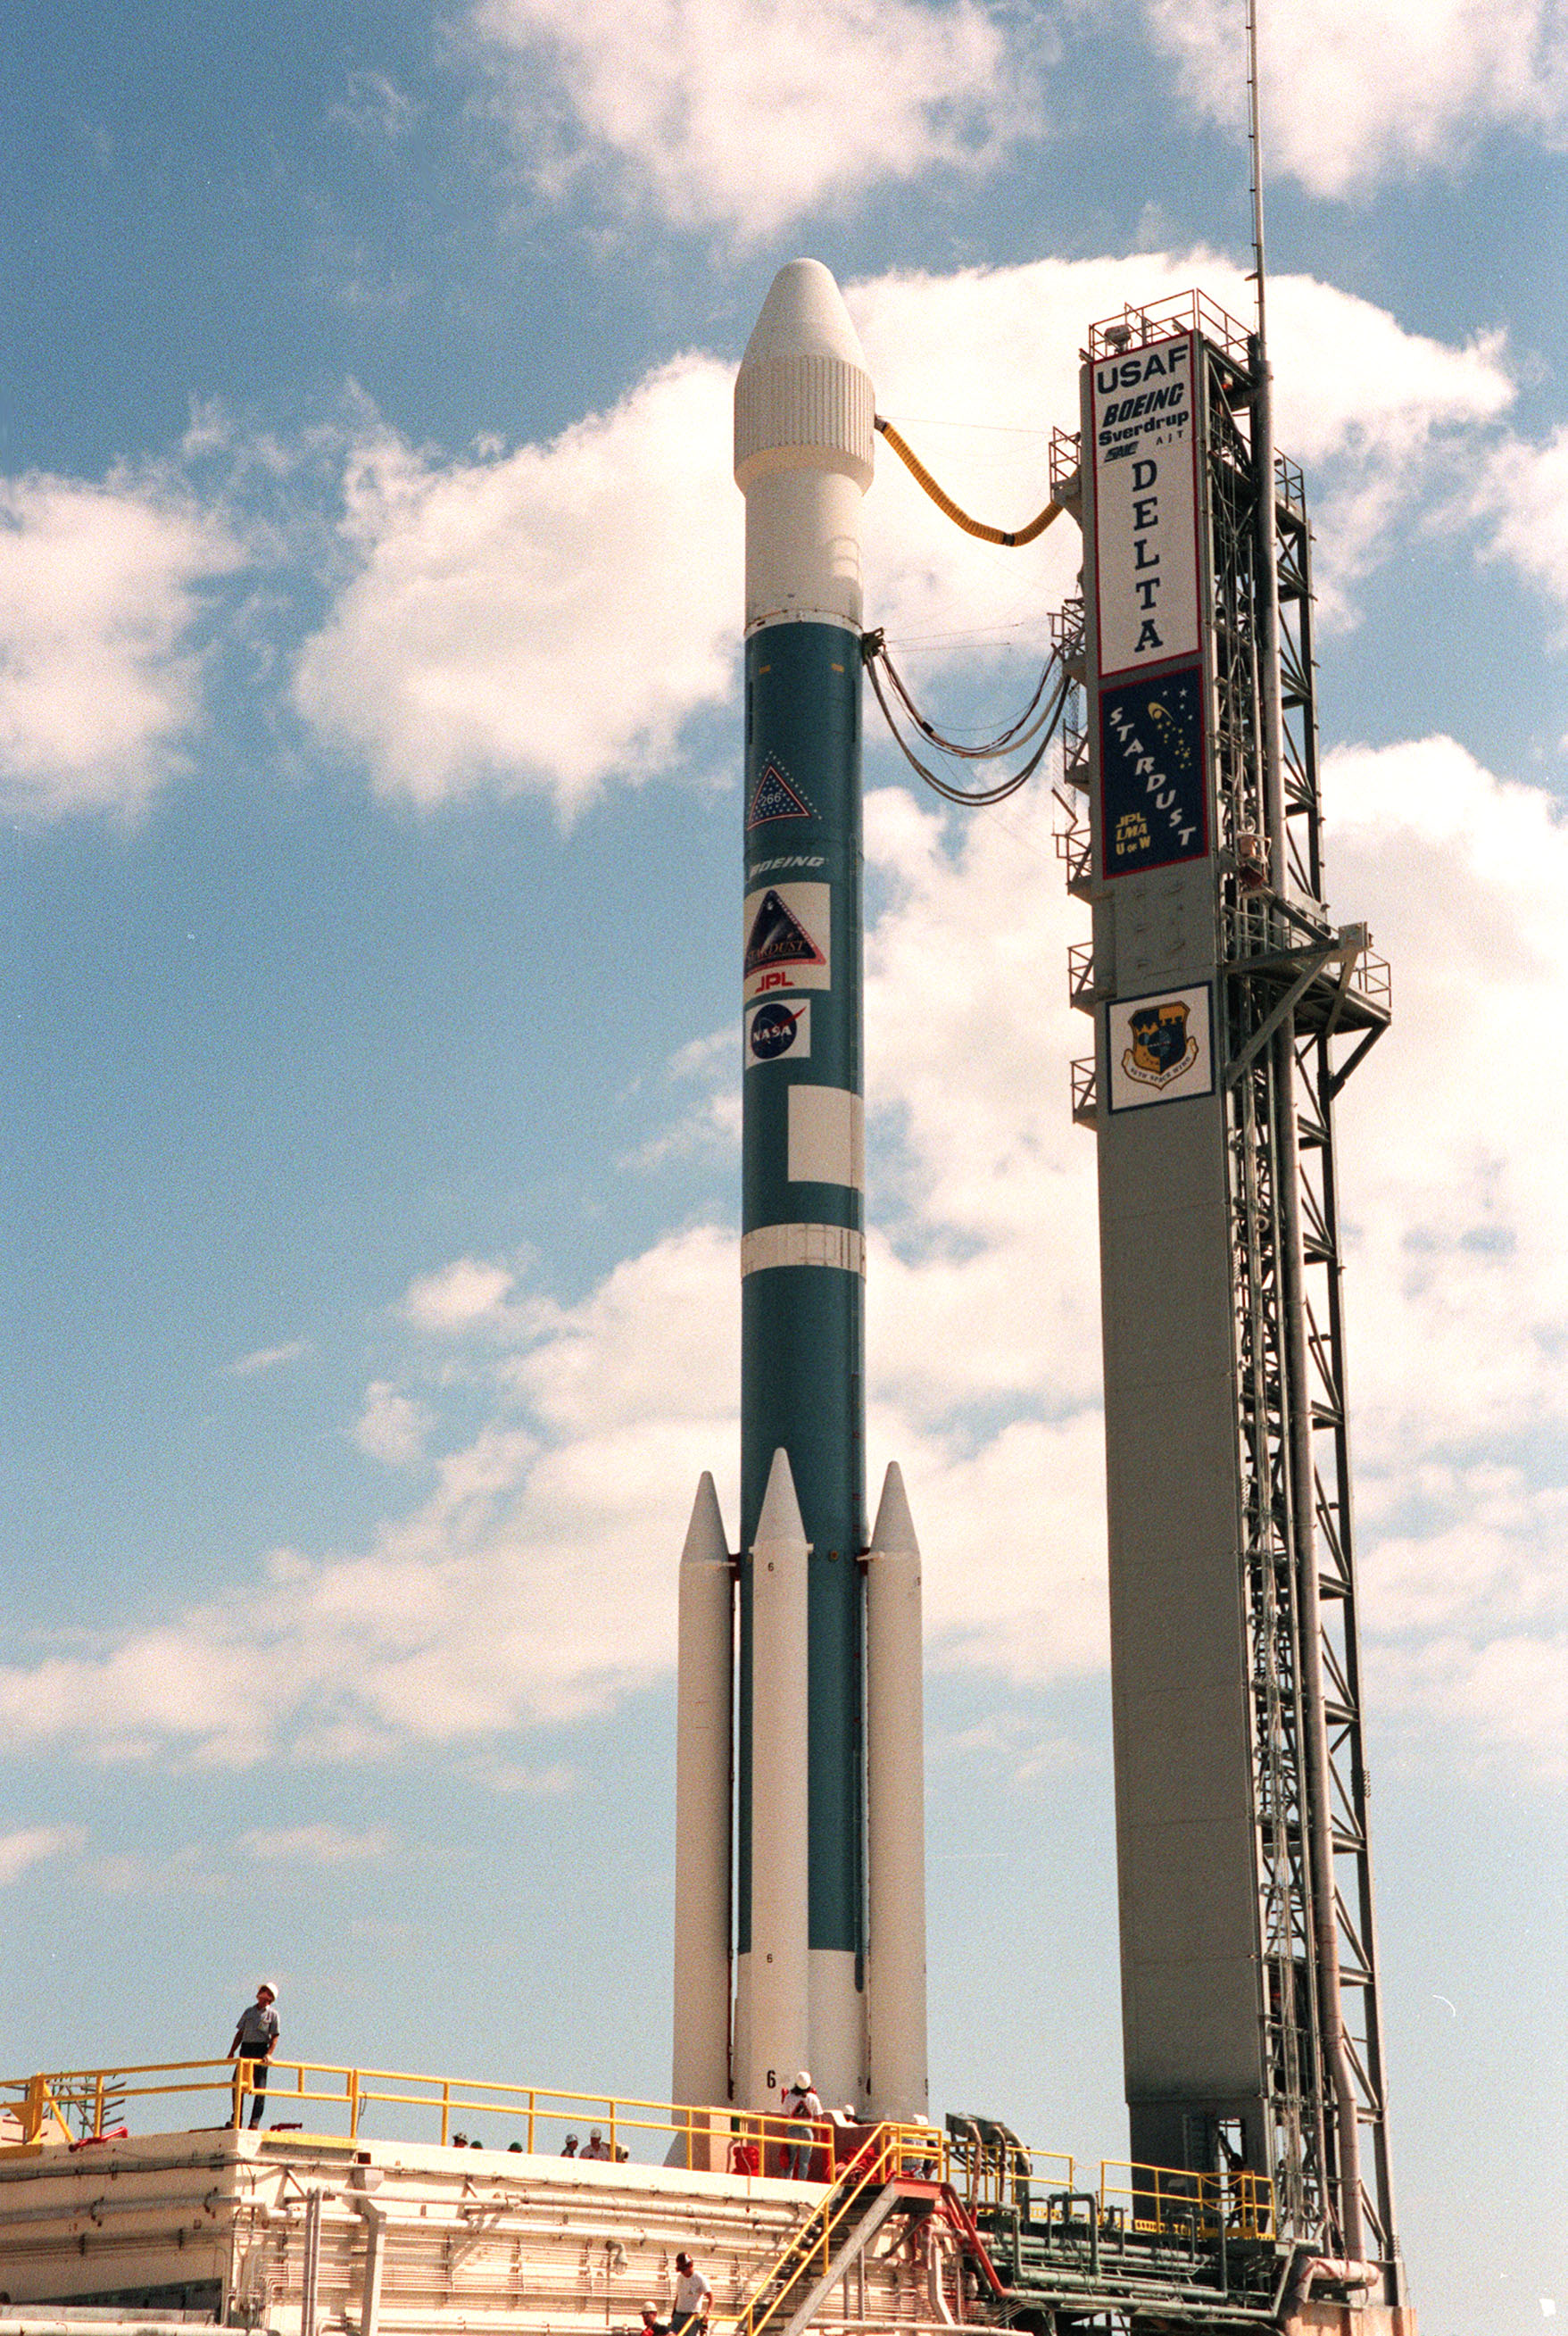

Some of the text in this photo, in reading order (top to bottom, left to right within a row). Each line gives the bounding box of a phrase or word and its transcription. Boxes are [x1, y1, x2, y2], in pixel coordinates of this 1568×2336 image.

[1097, 345, 1189, 395] USAF
[1102, 382, 1185, 428] BOEING
[1099, 411, 1190, 446] Sverdrup
[1132, 459, 1164, 653] DELTA
[1109, 707, 1196, 846] STARDUST
[760, 792, 782, 806] 266
[1116, 812, 1147, 828] JPL
[1116, 824, 1148, 842] LMA
[1116, 843, 1124, 856] U
[1139, 836, 1151, 850] W
[749, 856, 825, 877] BOEING
[755, 971, 794, 993] JPL
[751, 1025, 792, 1043] NASA
[767, 1562, 775, 1572] 6
[767, 1954, 773, 1964] 6
[767, 2070, 776, 2089] 6
